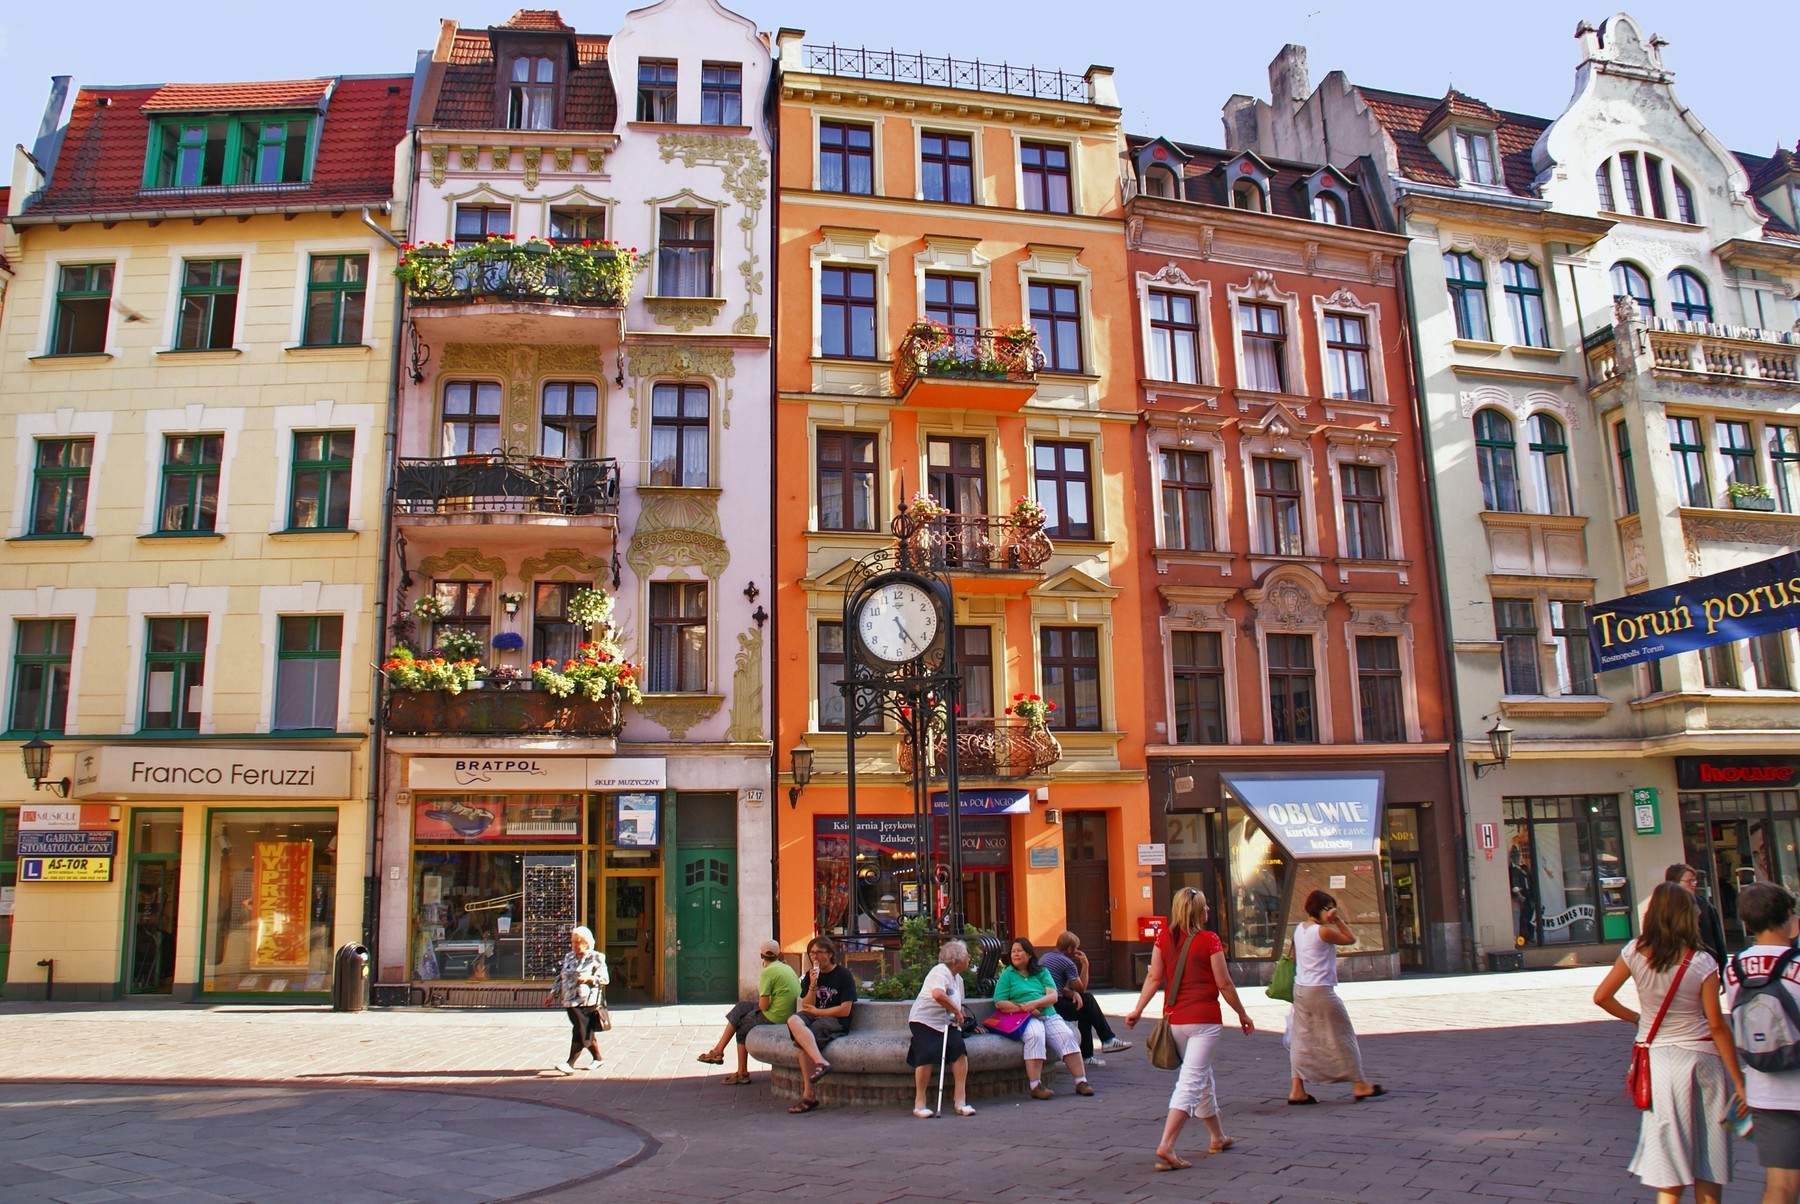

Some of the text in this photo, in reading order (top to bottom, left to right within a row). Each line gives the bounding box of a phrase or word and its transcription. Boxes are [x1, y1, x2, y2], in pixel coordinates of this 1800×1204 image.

[880, 596, 888, 604] 11
[893, 591, 903, 600] 12
[910, 593, 915, 601] 1
[870, 607, 881, 616] 10
[920, 603, 926, 612] 2
[866, 622, 873, 630] 9
[925, 617, 931, 626] 3
[1592, 595, 1694, 648] Toruń
[871, 636, 878, 644] 8
[920, 632, 927, 640] 4
[882, 645, 888, 654] 7
[911, 643, 917, 652] 5
[896, 648, 903, 657] 6
[1600, 644, 1665, 664] Kosmopolis Toruń
[455, 760, 541, 771] BRATPOL
[132, 761, 315, 786] Franco Feruzzi
[594, 779, 660, 787] SKLEP MUZYCZNY
[748, 791, 762, 800] 17 17
[1268, 801, 1369, 826] OBUWIE
[1167, 818, 1197, 844] 21
[45, 833, 86, 843] GABINET
[21, 843, 110, 853] STOMATOLOGICZNY
[48, 859, 88, 870] AS-TOR
[28, 862, 39, 877] L
[1557, 907, 1579, 925] LOVES
[1579, 905, 1594, 918] YOU
